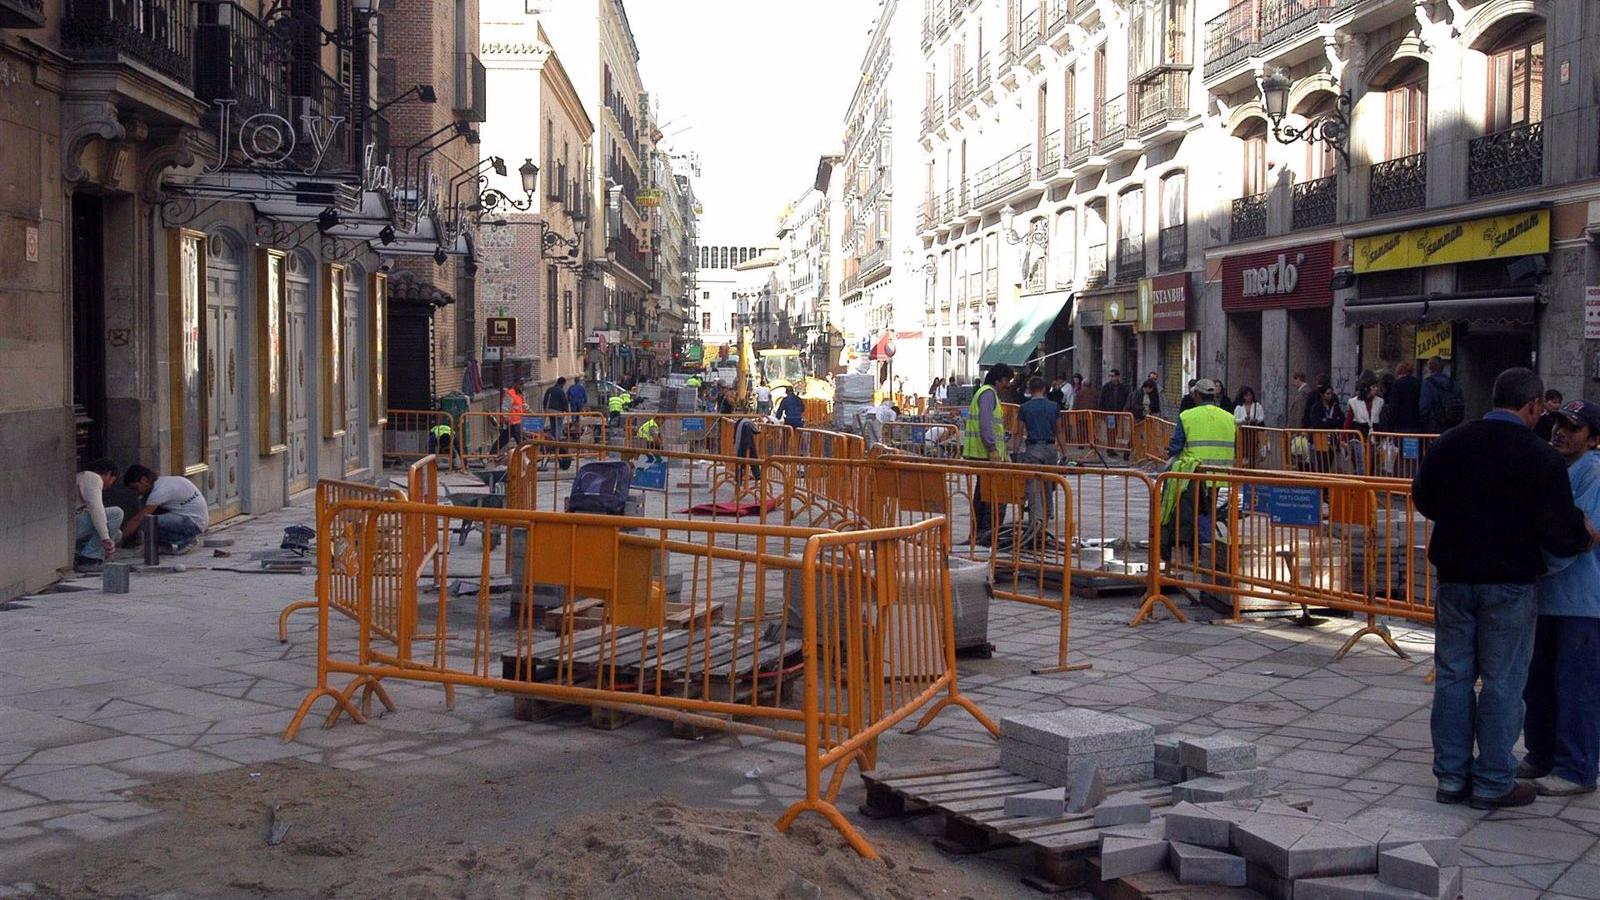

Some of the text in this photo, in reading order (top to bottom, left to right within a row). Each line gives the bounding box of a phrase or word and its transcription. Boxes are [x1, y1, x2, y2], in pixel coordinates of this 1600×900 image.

[638, 92, 649, 137] HOTEL
[1153, 287, 1185, 305] ISTANBUL
[1417, 327, 1450, 356] ZAPATOS
